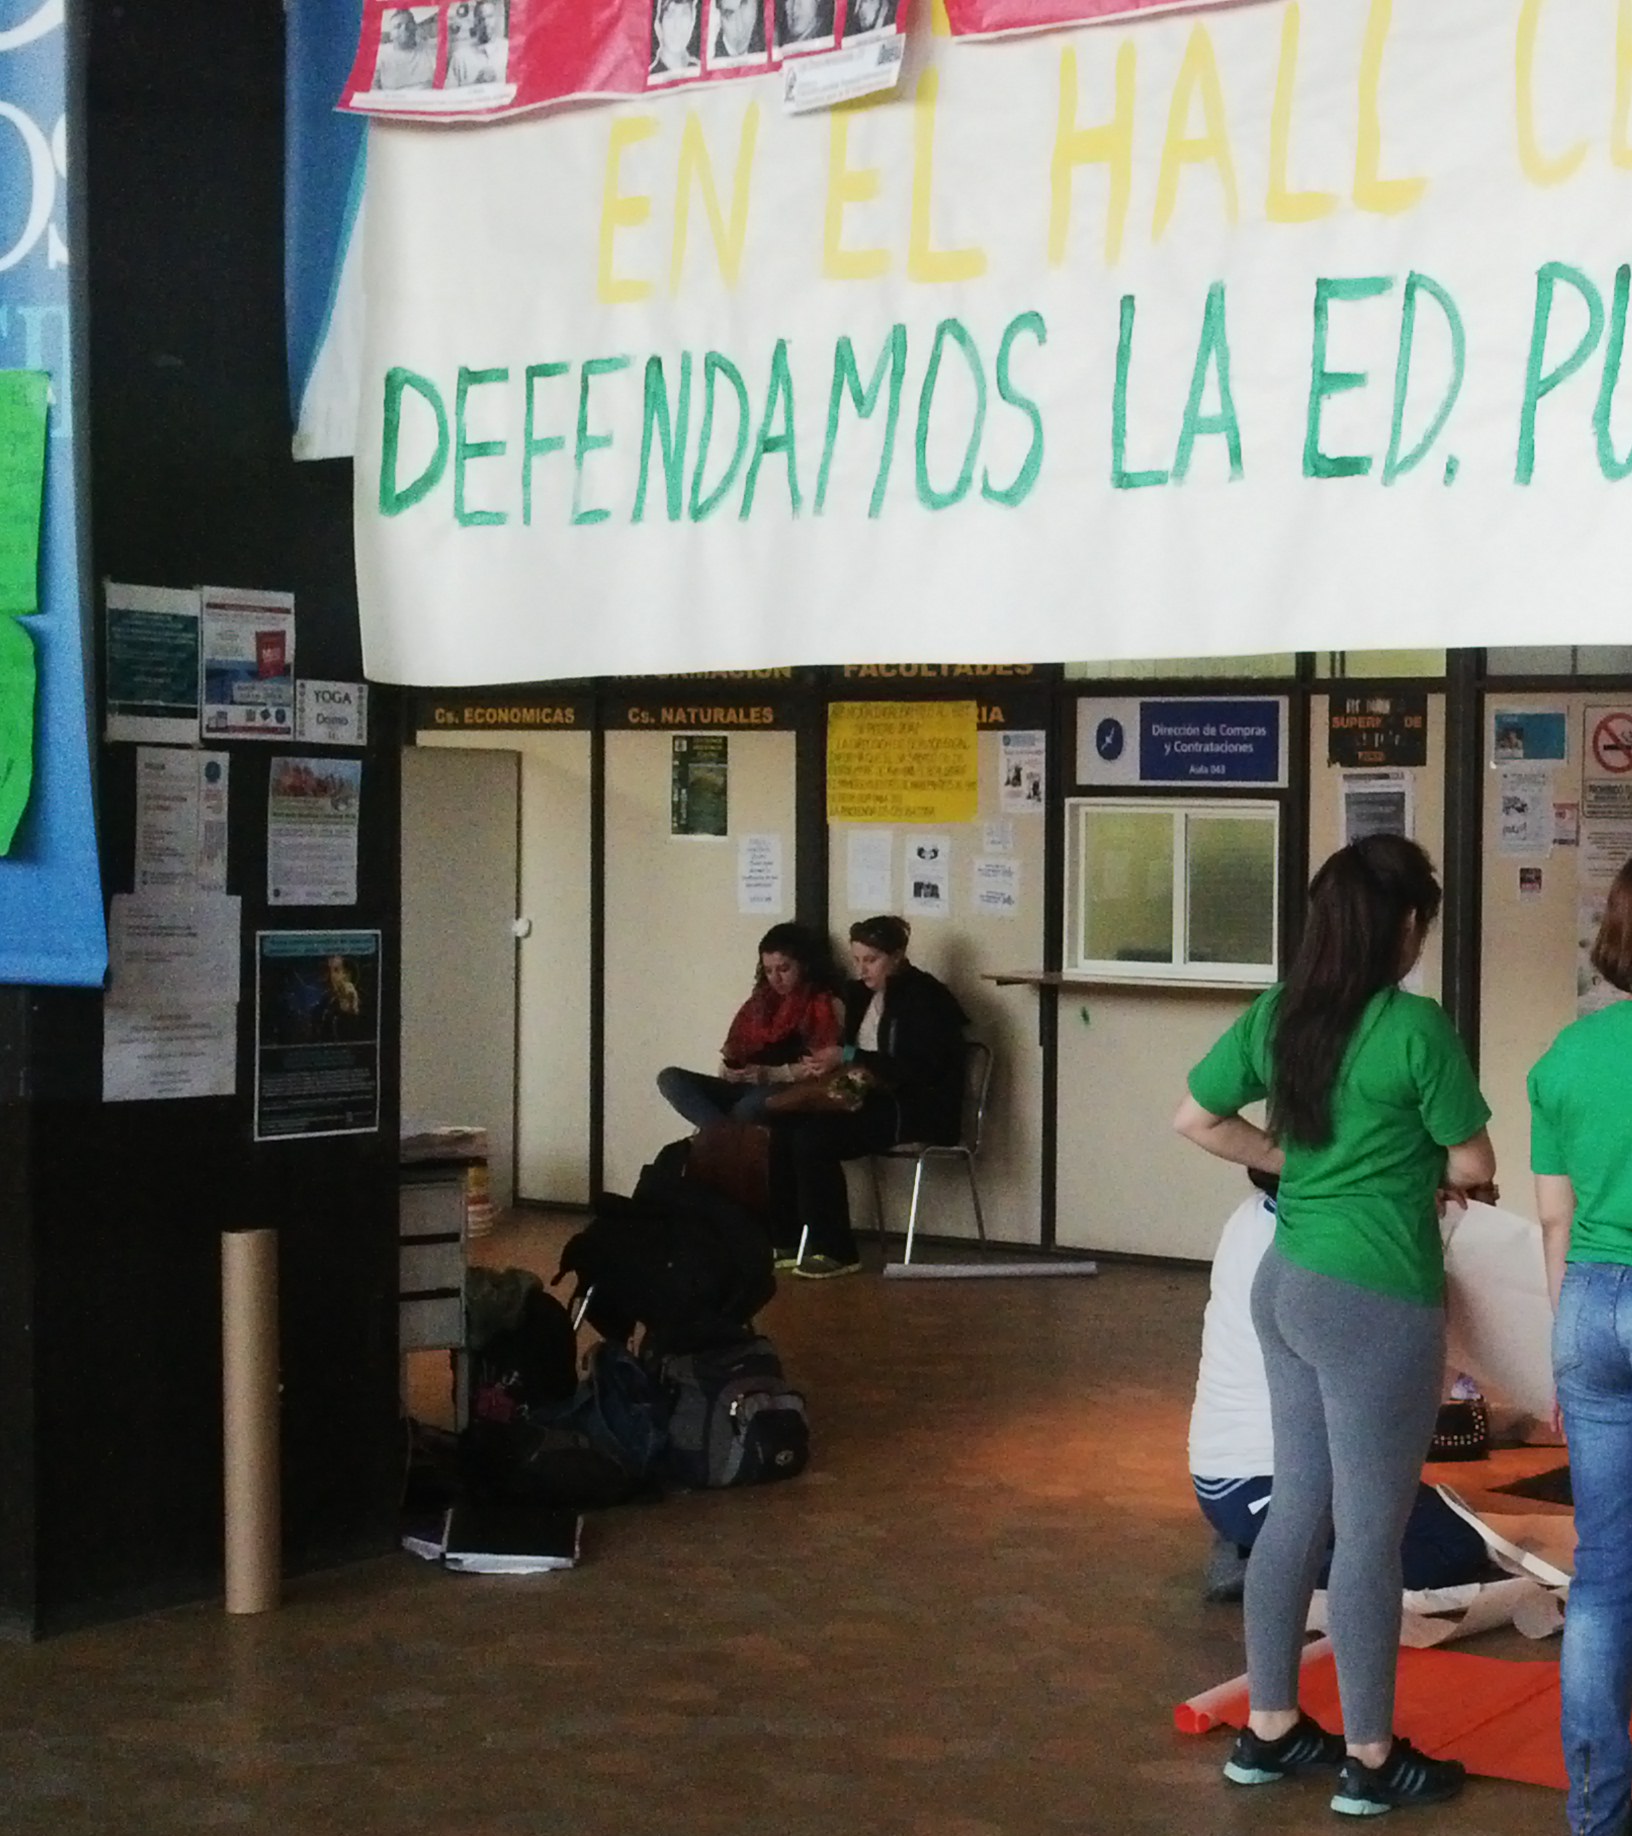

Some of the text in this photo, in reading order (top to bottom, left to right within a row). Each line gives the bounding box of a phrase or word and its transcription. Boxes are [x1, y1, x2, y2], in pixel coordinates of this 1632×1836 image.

[596, 98, 761, 304] EN
[821, 66, 989, 284] EL
[1048, 0, 1430, 270] HALL
[377, 309, 1048, 527] DEFENDAMOS
[1111, 280, 1246, 490] LA
[1302, 269, 1467, 487] ED.
[313, 689, 352, 705] YOGA
[434, 707, 459, 724] Cs.
[628, 707, 774, 724] Cs. NATURALES
[1151, 722, 1267, 739] Dirección de Compras
[1164, 740, 1254, 756] y Contrataciones
[1189, 764, 1208, 775] Aula
